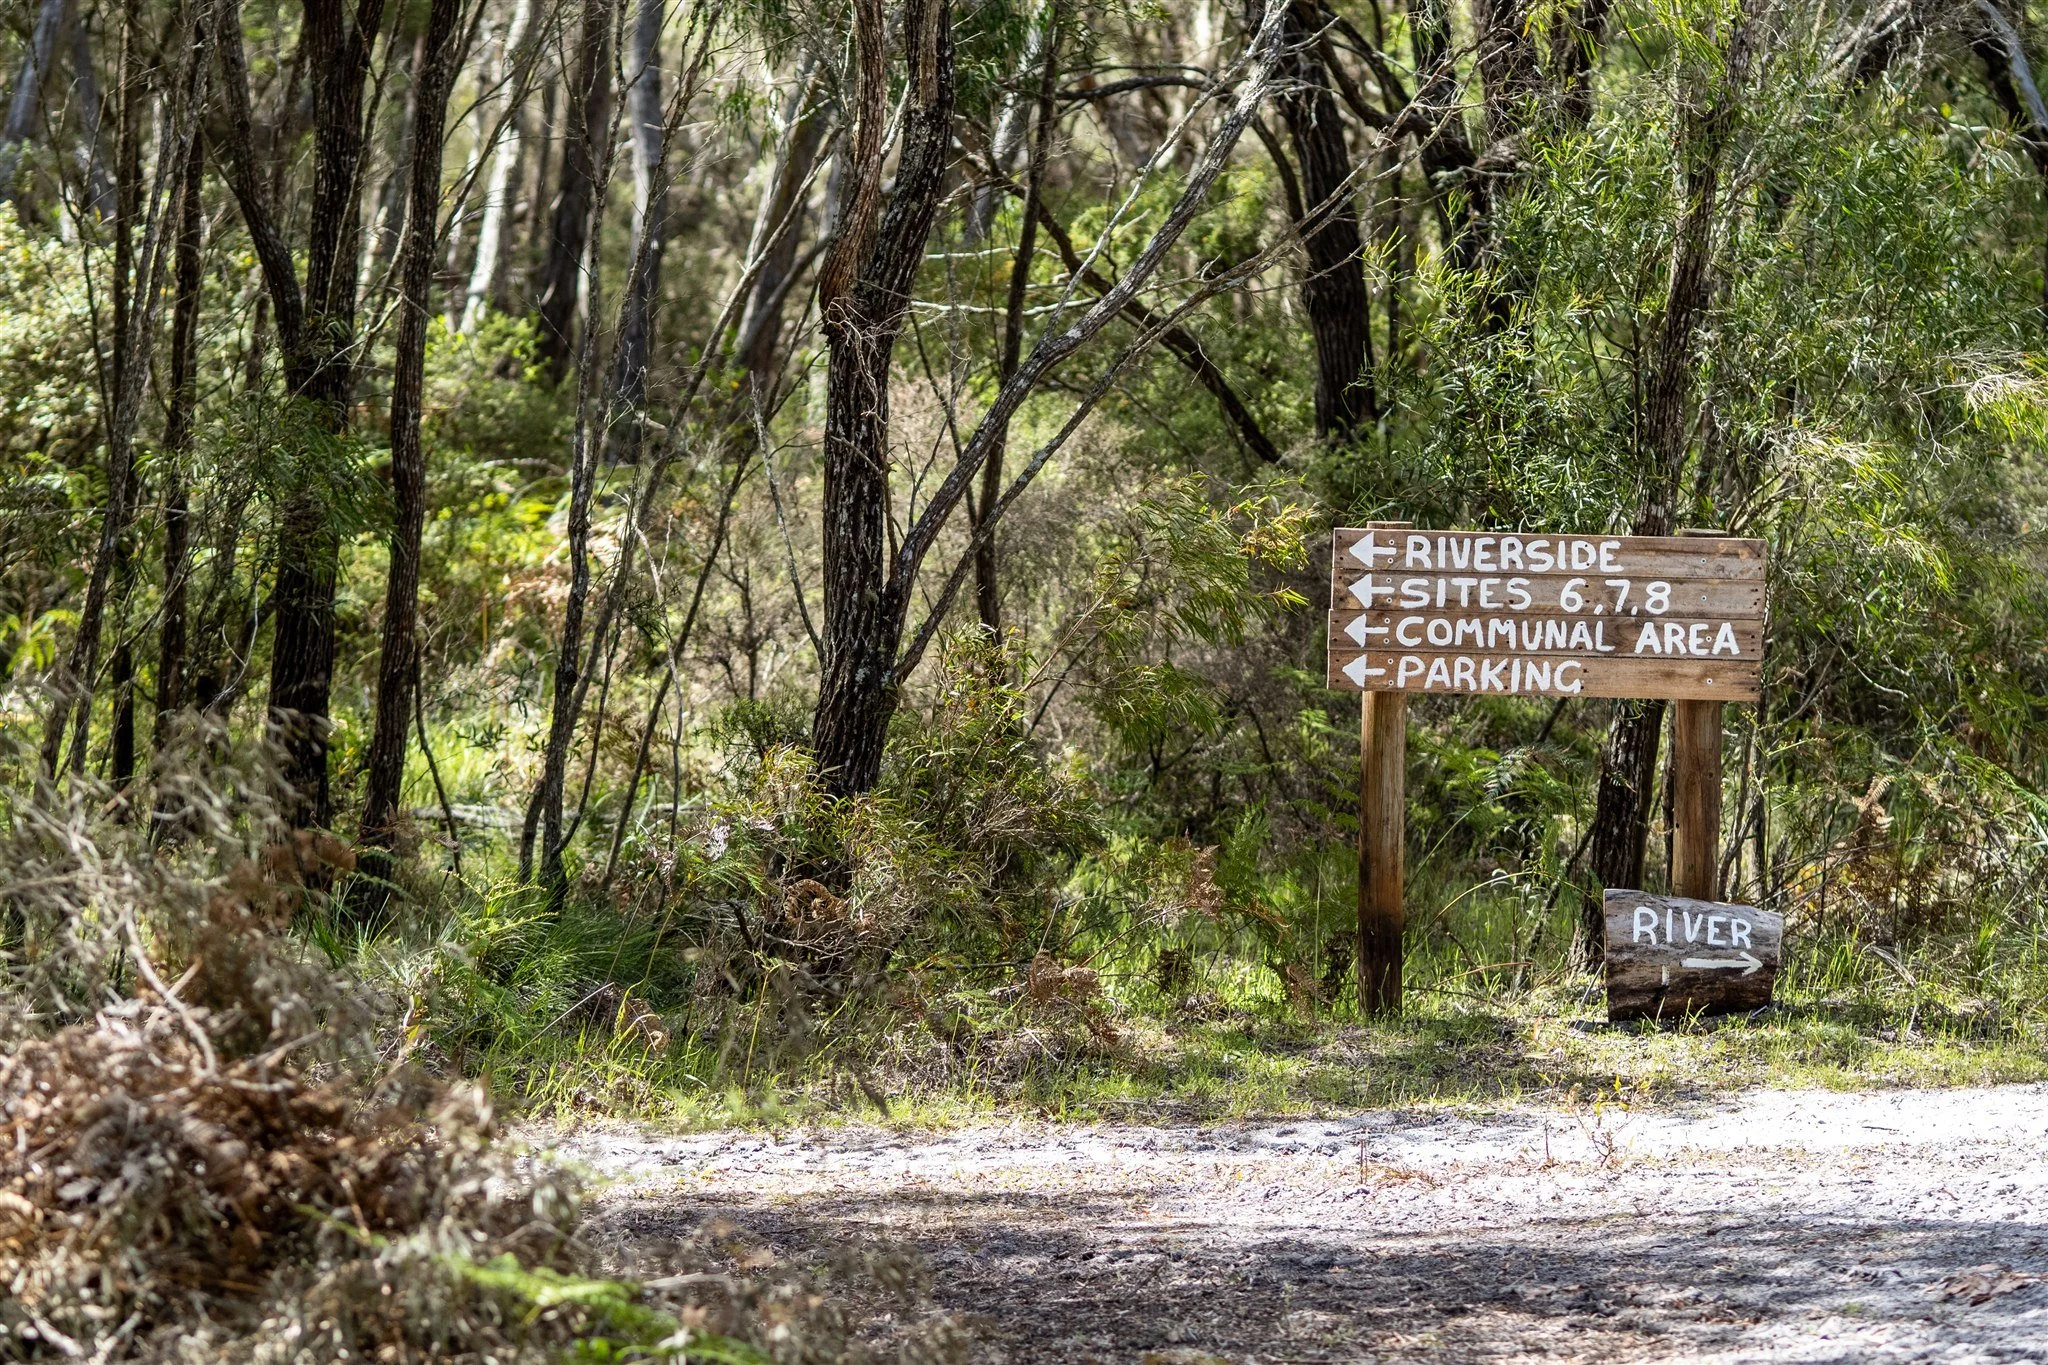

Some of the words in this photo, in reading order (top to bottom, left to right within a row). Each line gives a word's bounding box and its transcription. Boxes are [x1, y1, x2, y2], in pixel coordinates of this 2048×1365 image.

[1405, 535, 1625, 573] RIVERSIDE
[1399, 577, 1531, 611] SITES
[1395, 615, 1615, 652] COMMUNAL
[1634, 622, 1740, 656] AREA
[1396, 655, 1582, 695] PARKING
[1633, 906, 1752, 950] RIVER
